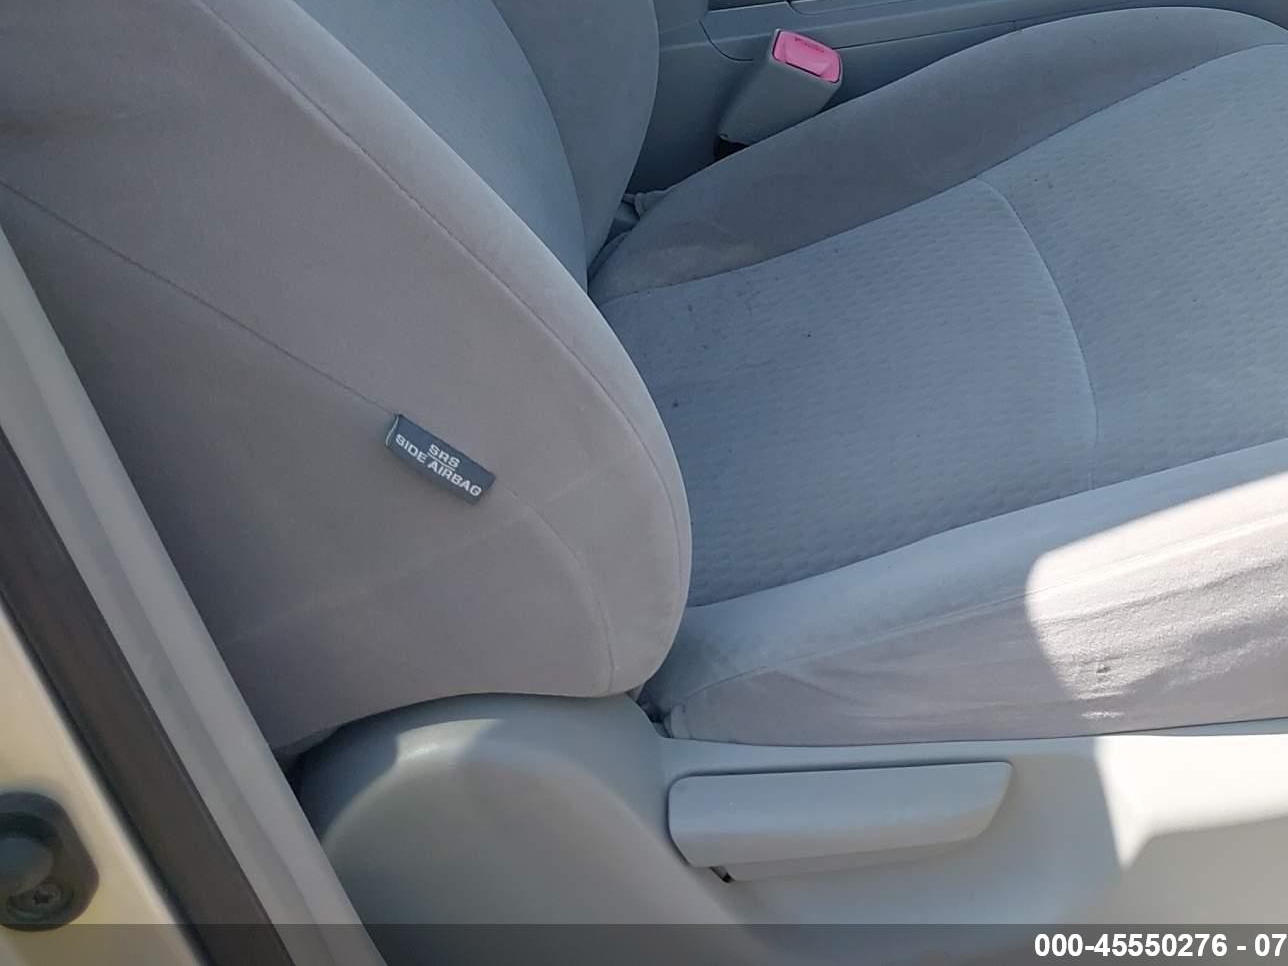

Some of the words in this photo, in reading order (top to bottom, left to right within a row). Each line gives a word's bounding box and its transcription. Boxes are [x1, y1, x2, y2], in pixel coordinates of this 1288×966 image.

[395, 434, 426, 464] SIDE
[427, 461, 482, 496] AIRBAG
[428, 444, 461, 468] SRS
